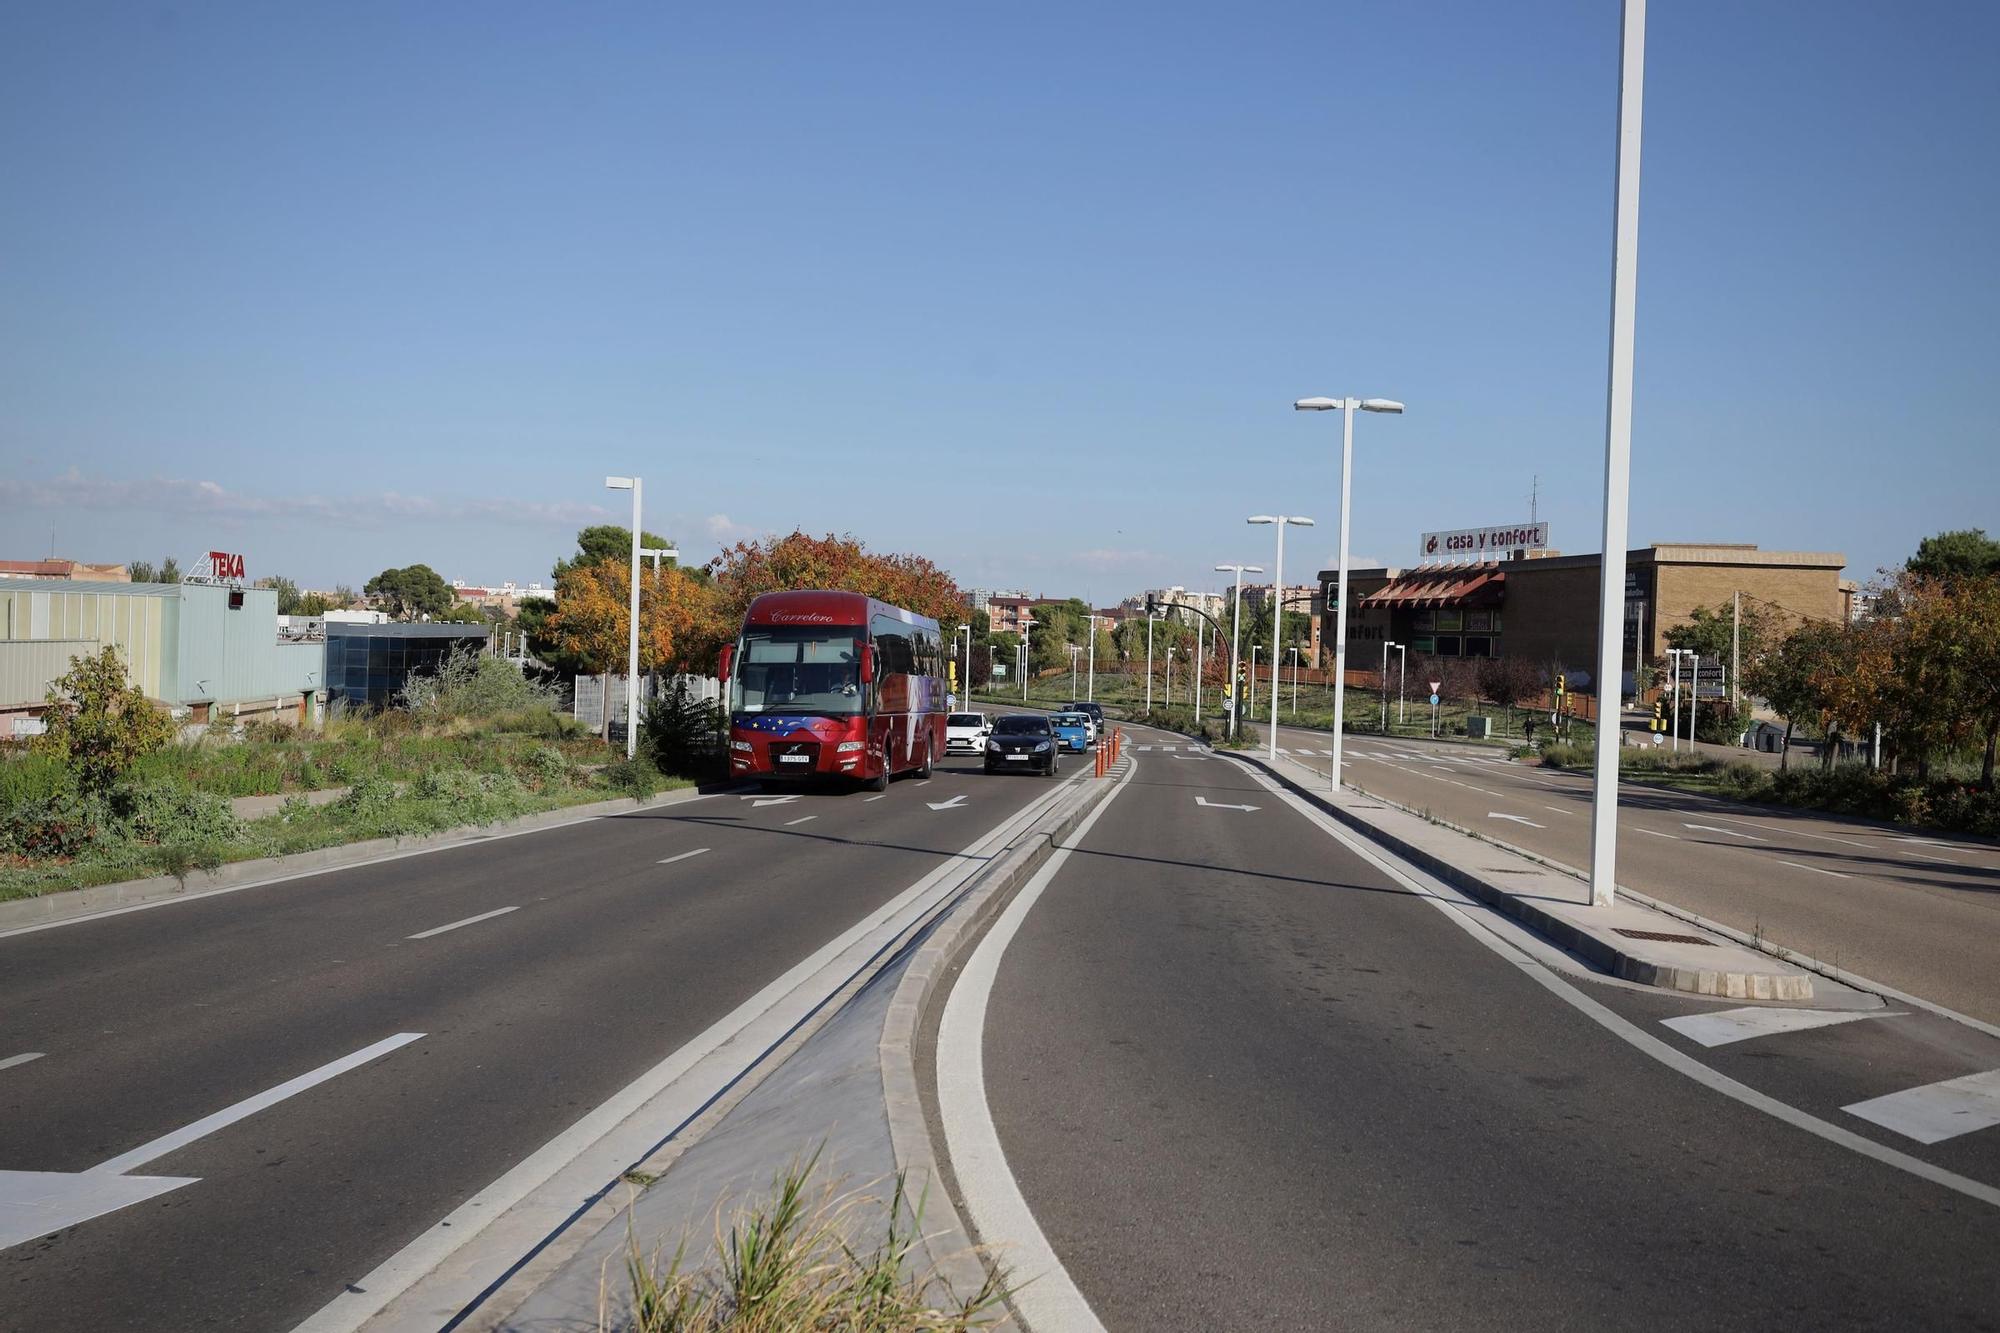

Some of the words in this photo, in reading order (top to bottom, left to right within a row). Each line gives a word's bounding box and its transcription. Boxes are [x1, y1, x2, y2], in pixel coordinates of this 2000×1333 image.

[1446, 534, 1473, 550] casa
[1479, 532, 1486, 549] y
[1491, 527, 1540, 547] confort
[209, 551, 245, 578] TEKA
[770, 609, 834, 623] Carretero
